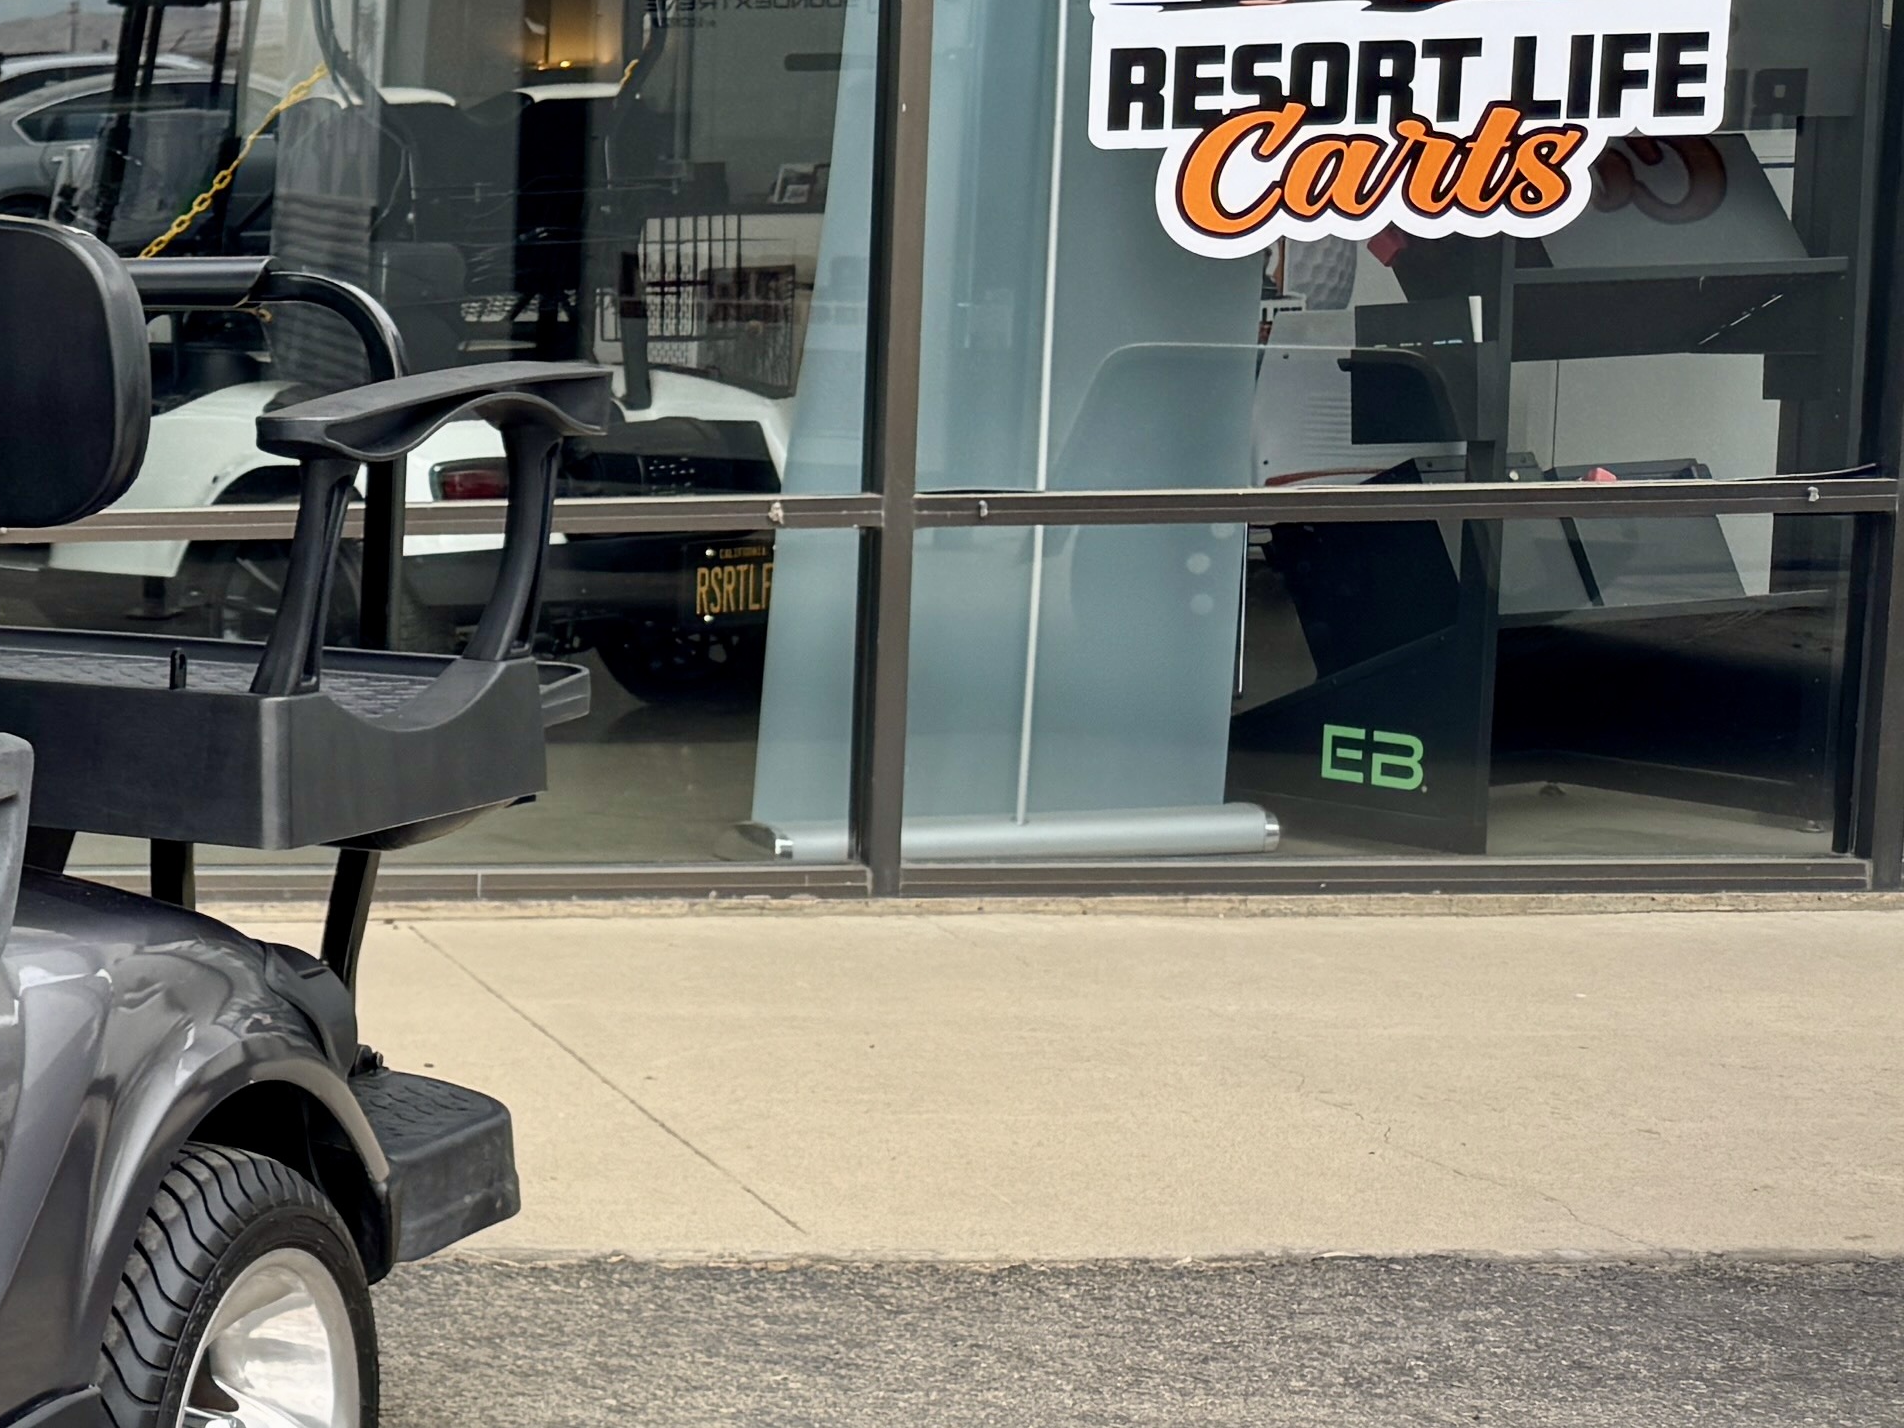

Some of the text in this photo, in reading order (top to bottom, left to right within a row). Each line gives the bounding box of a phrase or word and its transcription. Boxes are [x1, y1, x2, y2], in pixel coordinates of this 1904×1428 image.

[1107, 35, 1483, 132] RESORT
[1512, 31, 1710, 120] LIFE
[1176, 101, 1591, 235] Carts
[1321, 724, 1425, 792] EB
